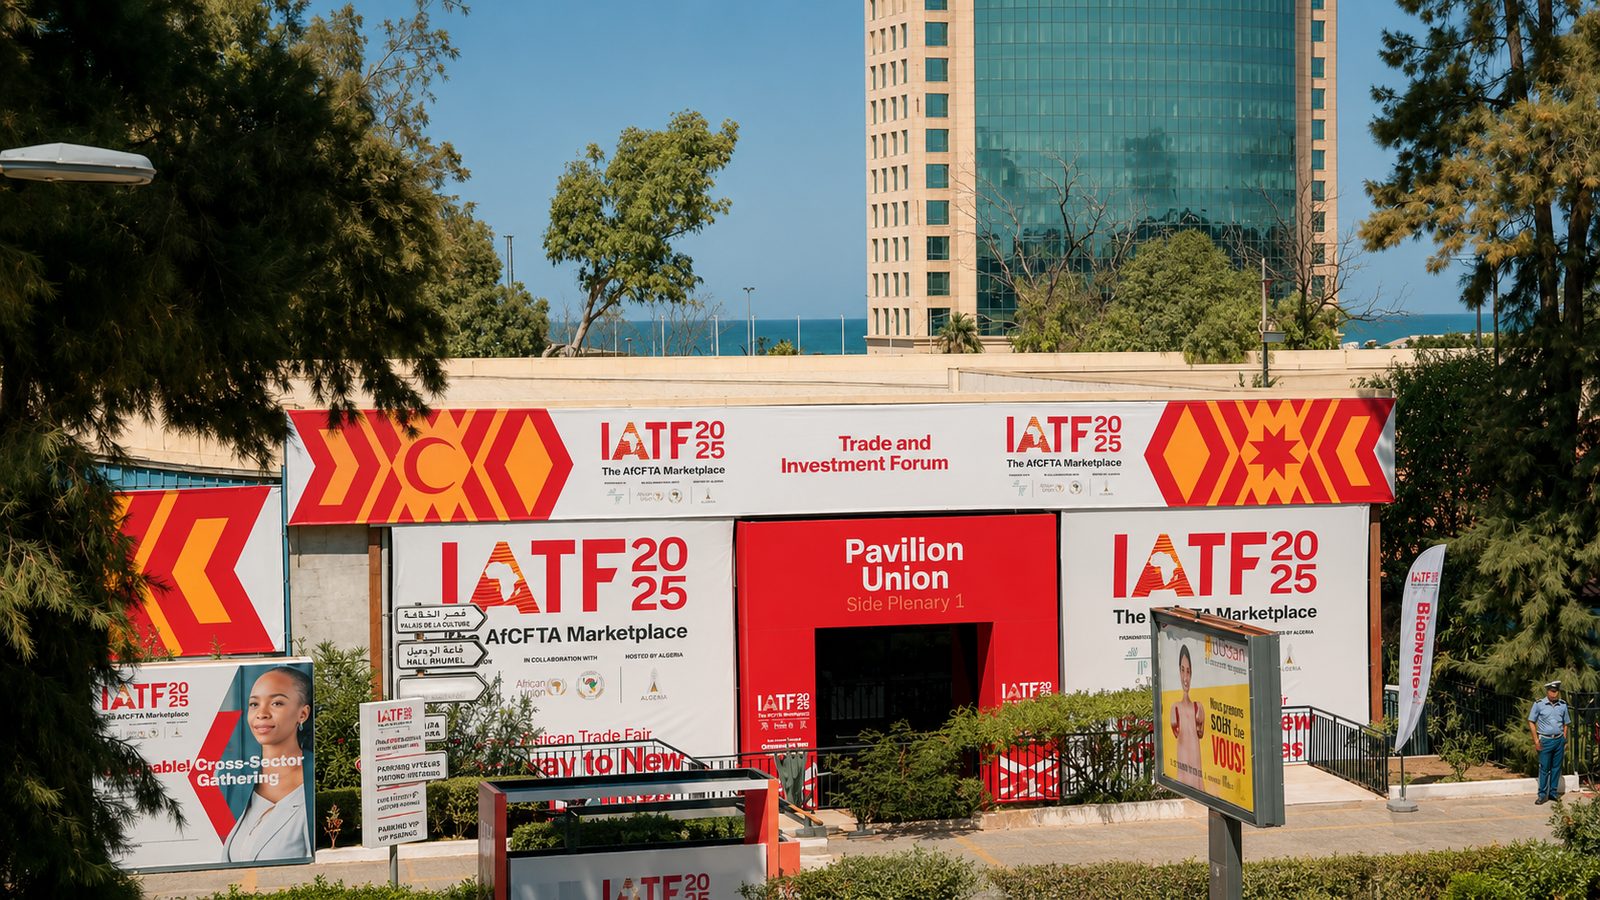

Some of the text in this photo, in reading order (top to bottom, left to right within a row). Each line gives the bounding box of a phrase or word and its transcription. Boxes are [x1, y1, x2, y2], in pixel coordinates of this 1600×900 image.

[695, 420, 725, 439] 20
[1094, 415, 1122, 433] 20
[601, 421, 693, 460] IATF
[839, 434, 931, 452] Trade and
[1006, 416, 1092, 453] IATF
[1094, 435, 1122, 452] 25
[695, 441, 725, 459] 25
[602, 465, 726, 476] The AfCFTA Marketplace
[781, 454, 949, 474] Investment Forum
[1006, 459, 1122, 468] The AfCFTA Marketplace
[631, 537, 688, 572] 20
[845, 537, 964, 564] Pavilion
[1271, 530, 1319, 561] 20
[1113, 532, 1267, 598] IATF
[442, 538, 626, 614] IATF
[861, 566, 949, 592] Union
[1270, 564, 1318, 594] 25
[1411, 571, 1431, 582] IATF
[631, 575, 688, 611] 25
[847, 594, 965, 614] Side Plenary 1
[1113, 609, 1146, 624] The
[1217, 605, 1318, 622] Marketplace
[485, 627, 561, 645] AfCFTA
[569, 623, 688, 645] Marketplace
[168, 682, 189, 694] 20
[516, 679, 546, 688] African
[1001, 682, 1039, 699] IATF
[1040, 681, 1052, 689] 20
[102, 682, 167, 711] IATF
[168, 695, 189, 708] 25
[520, 689, 546, 700] Union
[757, 694, 796, 711] IATF
[797, 693, 809, 701] 20
[797, 701, 809, 710] 25
[146, 711, 189, 719] Marketplace
[378, 708, 403, 723] IATF
[578, 730, 621, 743] Trade
[625, 728, 652, 741] Fair
[195, 755, 304, 771] Cross-Sector
[583, 750, 613, 775] to
[620, 747, 685, 773] New
[1211, 735, 1246, 775] VOUS!
[197, 771, 280, 787] Gathering
[602, 875, 682, 900] IATF
[684, 873, 710, 891] 20
